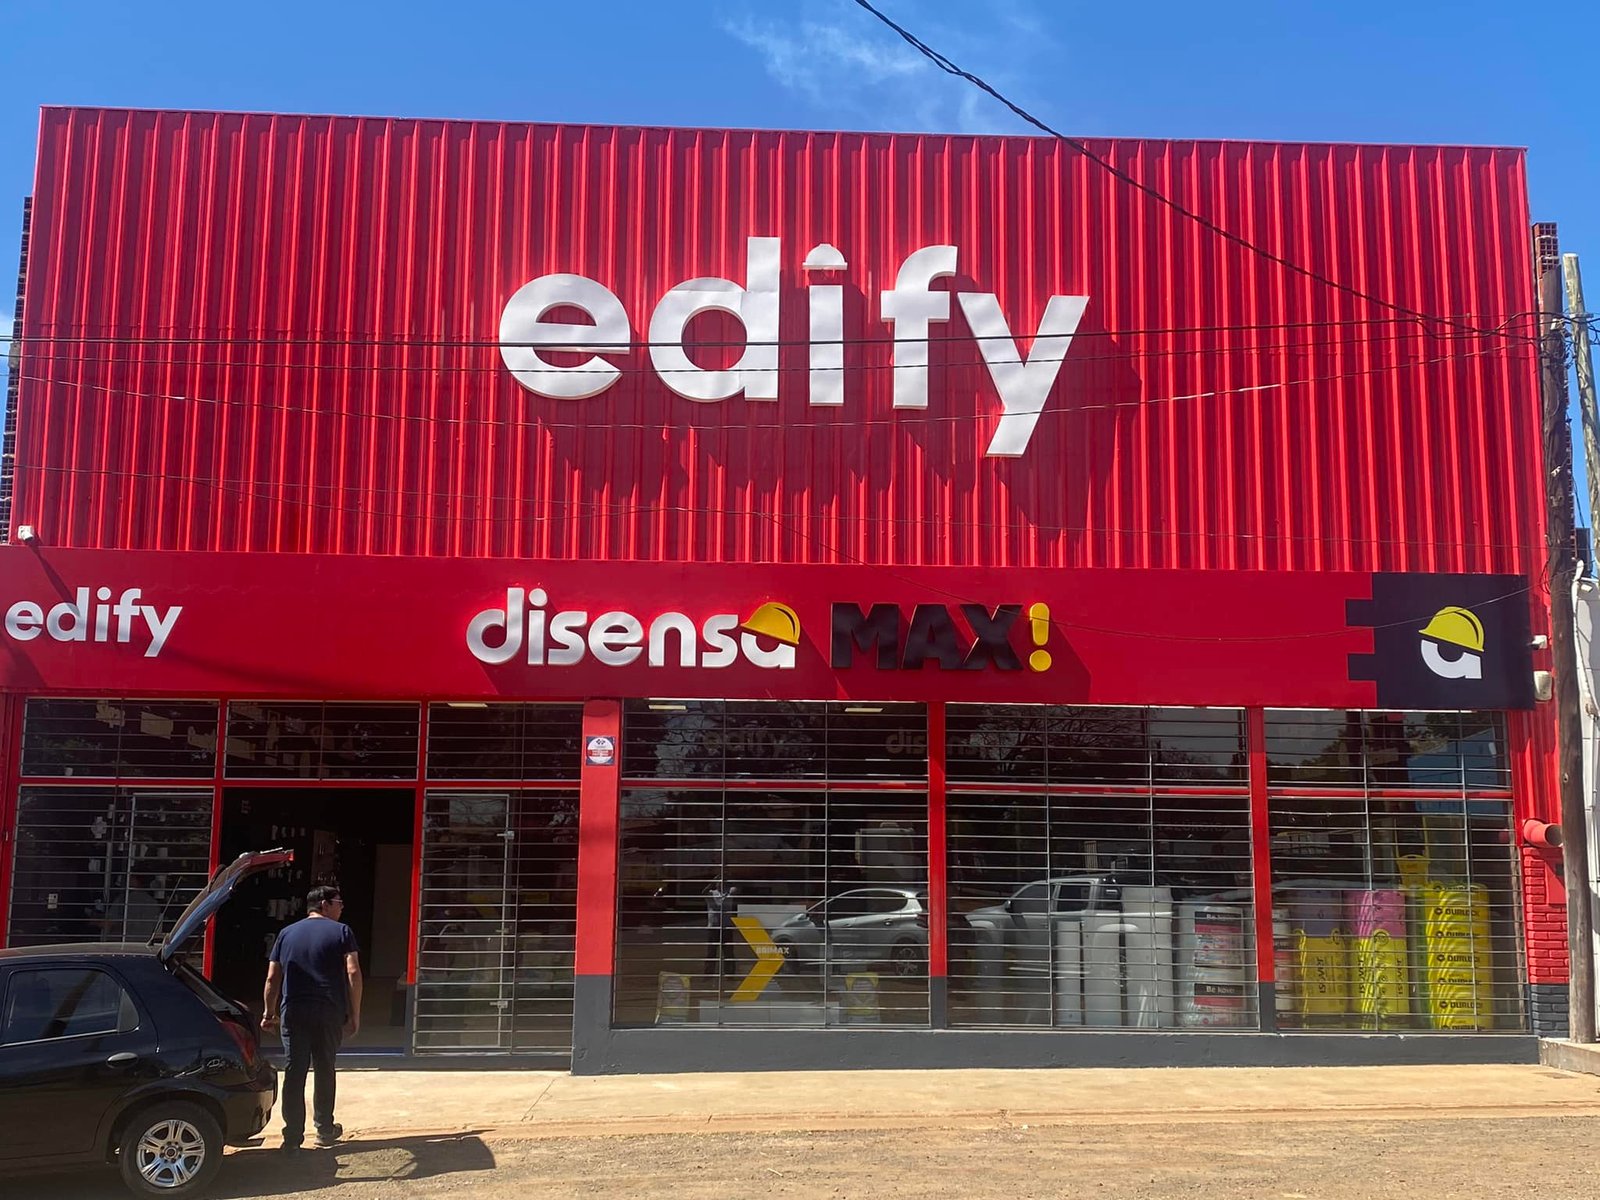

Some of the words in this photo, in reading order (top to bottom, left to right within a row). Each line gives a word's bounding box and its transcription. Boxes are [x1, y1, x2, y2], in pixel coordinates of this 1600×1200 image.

[499, 237, 1089, 457] edify
[5, 587, 183, 657] edify
[466, 588, 799, 669] disensa
[831, 602, 1052, 672] MAX!
